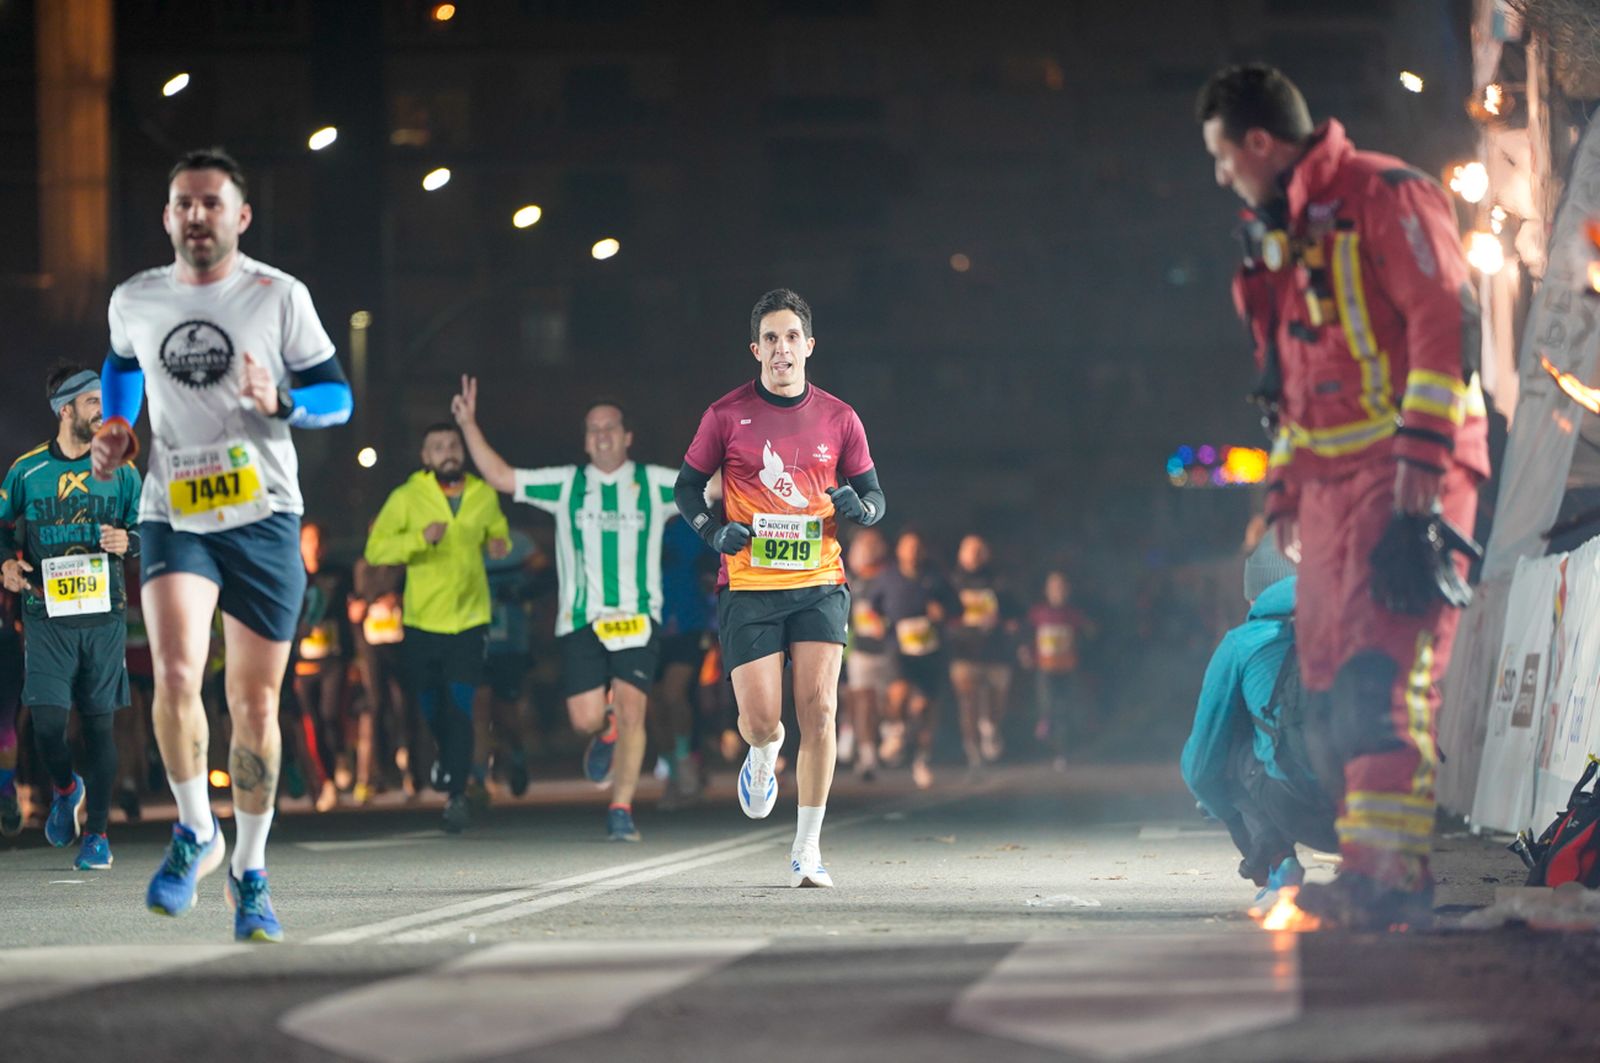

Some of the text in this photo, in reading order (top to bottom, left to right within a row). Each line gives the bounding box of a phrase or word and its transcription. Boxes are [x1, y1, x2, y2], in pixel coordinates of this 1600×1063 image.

[186, 472, 240, 506] 7447
[773, 477, 793, 498] 43
[758, 530, 773, 538] SAN
[767, 522, 790, 530] NOCHE
[765, 539, 811, 561] 9219
[57, 576, 97, 596] 5769
